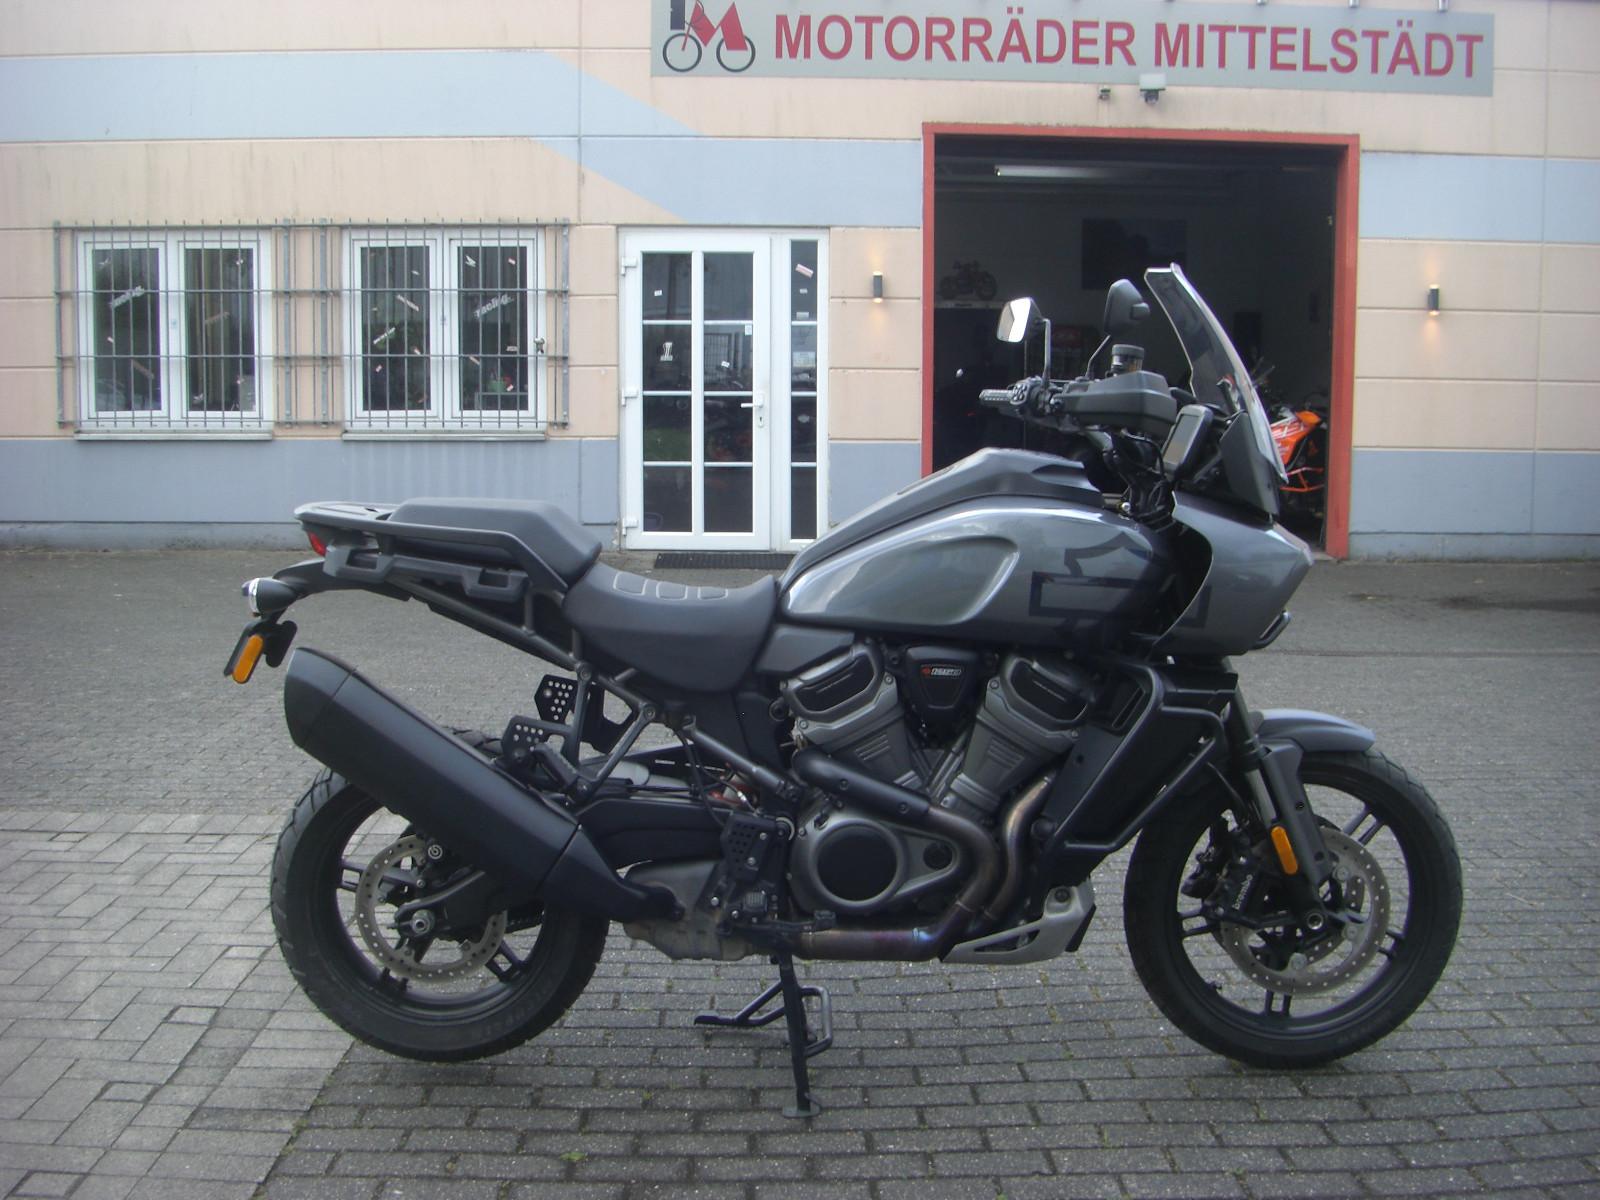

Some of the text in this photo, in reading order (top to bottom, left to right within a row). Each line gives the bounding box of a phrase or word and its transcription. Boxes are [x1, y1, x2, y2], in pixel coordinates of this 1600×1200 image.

[775, 7, 1484, 78] MOTORRÄDER MITTELSTÄDT
[1232, 874, 1254, 910] brembo
